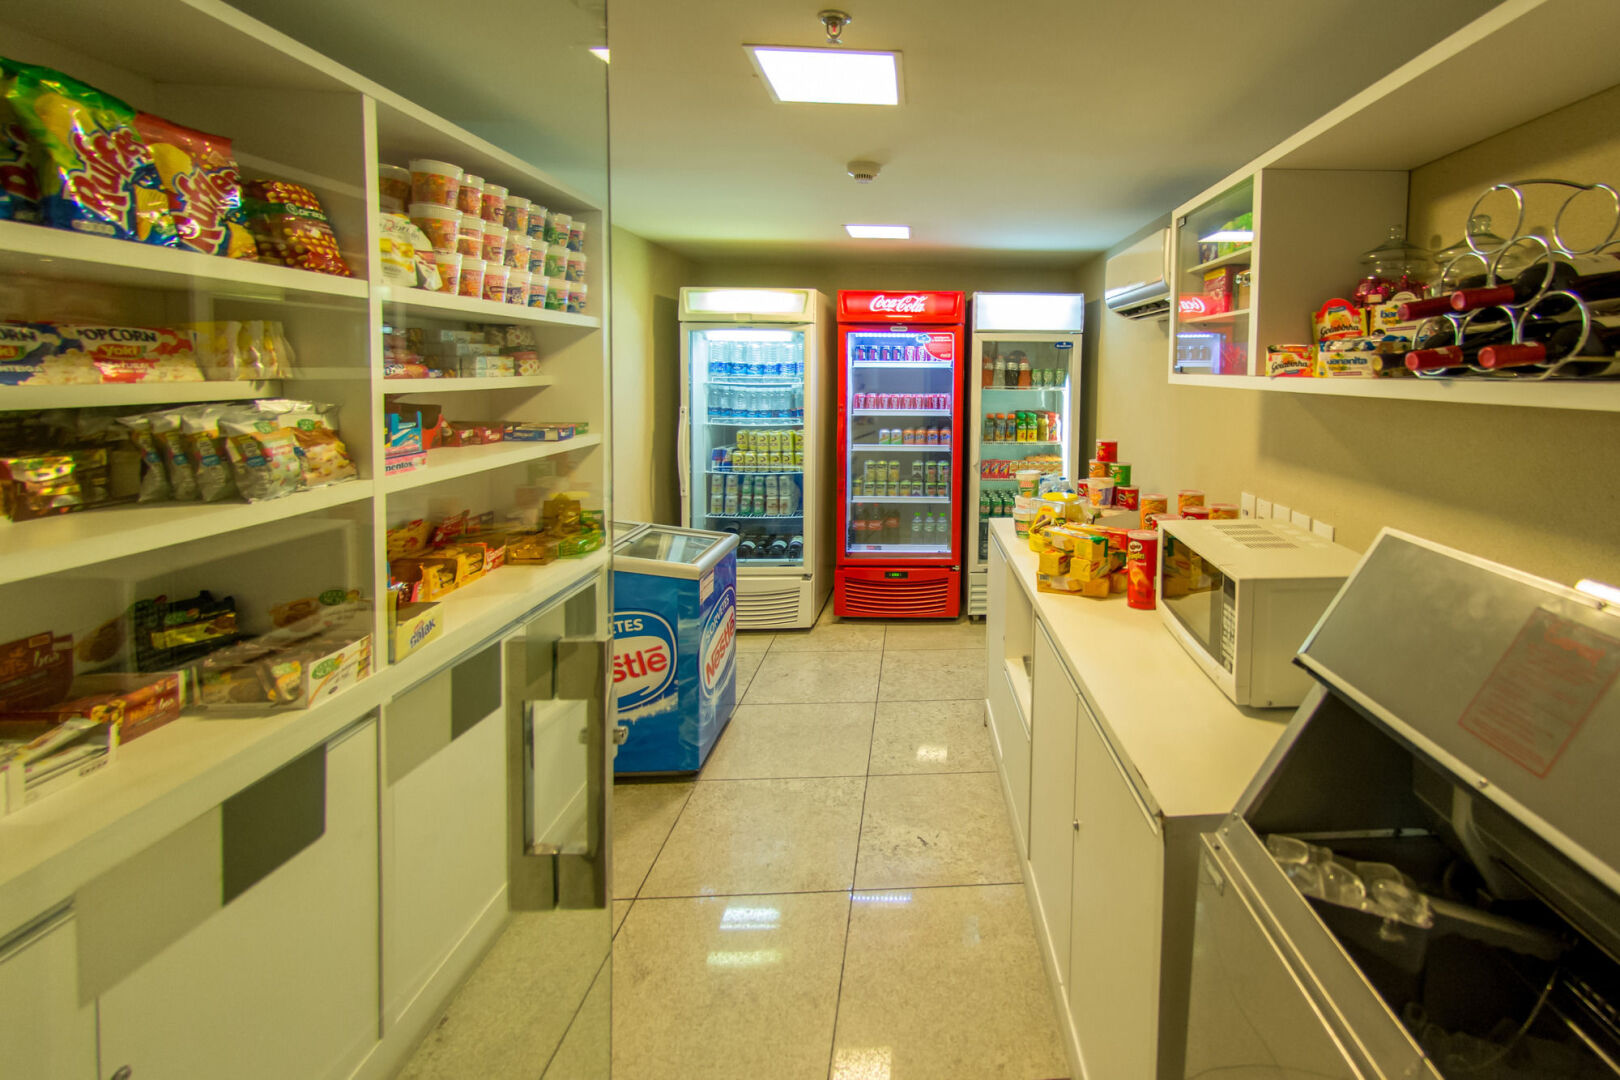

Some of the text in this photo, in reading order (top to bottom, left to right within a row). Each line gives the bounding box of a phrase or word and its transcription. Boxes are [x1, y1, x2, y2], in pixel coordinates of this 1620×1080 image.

[869, 294, 929, 313] Coca-Cola
[75, 327, 158, 343] POPCORN
[705, 612, 736, 686] Nestlé
